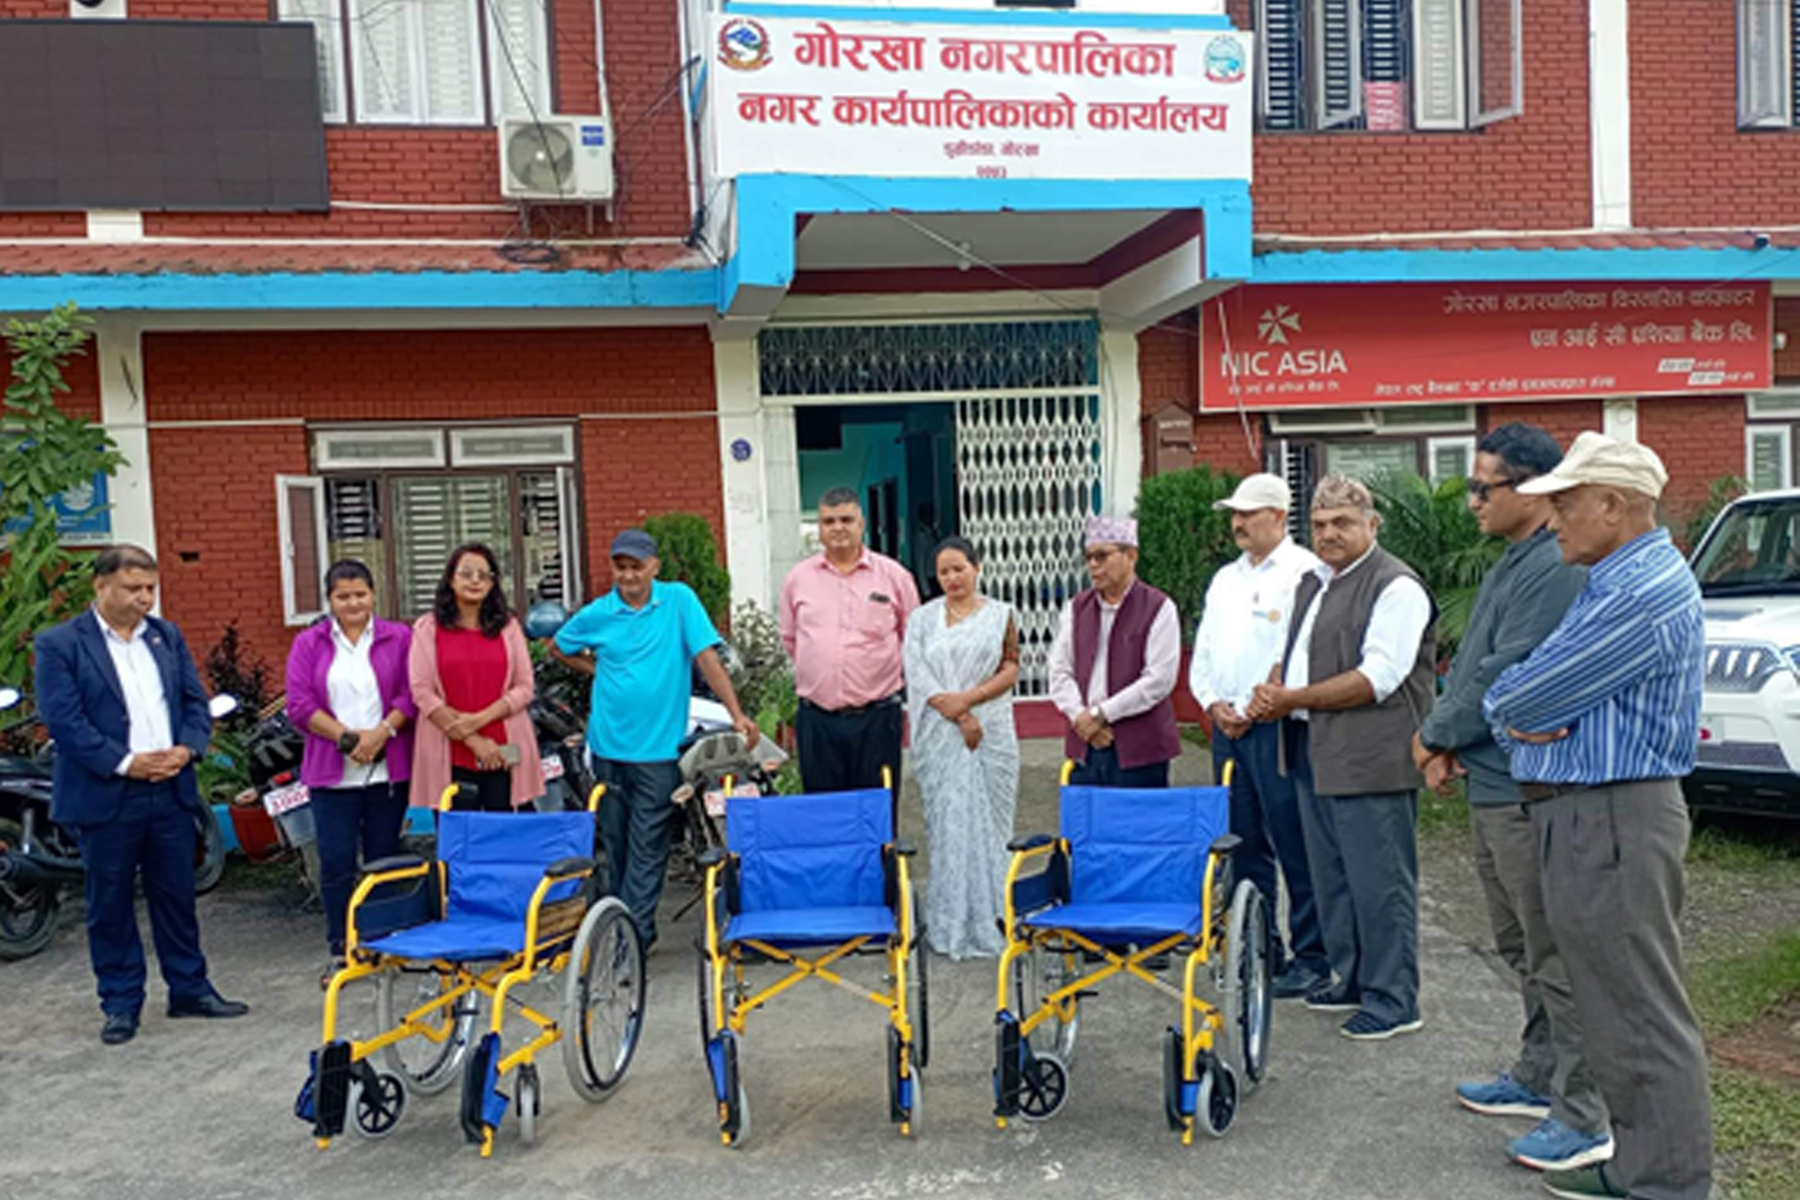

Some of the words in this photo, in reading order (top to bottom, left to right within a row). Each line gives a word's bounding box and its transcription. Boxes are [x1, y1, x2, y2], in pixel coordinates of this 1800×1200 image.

[793, 22, 926, 71] गोरखा
[939, 31, 1177, 77] नगरपालिका
[737, 93, 822, 127] नगर
[833, 89, 1076, 130] कार्यपालिकाको
[1087, 96, 1229, 133] कार्यालय
[1504, 290, 1607, 311] नगरपालिका
[1563, 321, 1599, 348] आई
[1603, 323, 1627, 346] सी
[1221, 351, 1270, 377] NIC
[1277, 349, 1348, 376] ASIA
